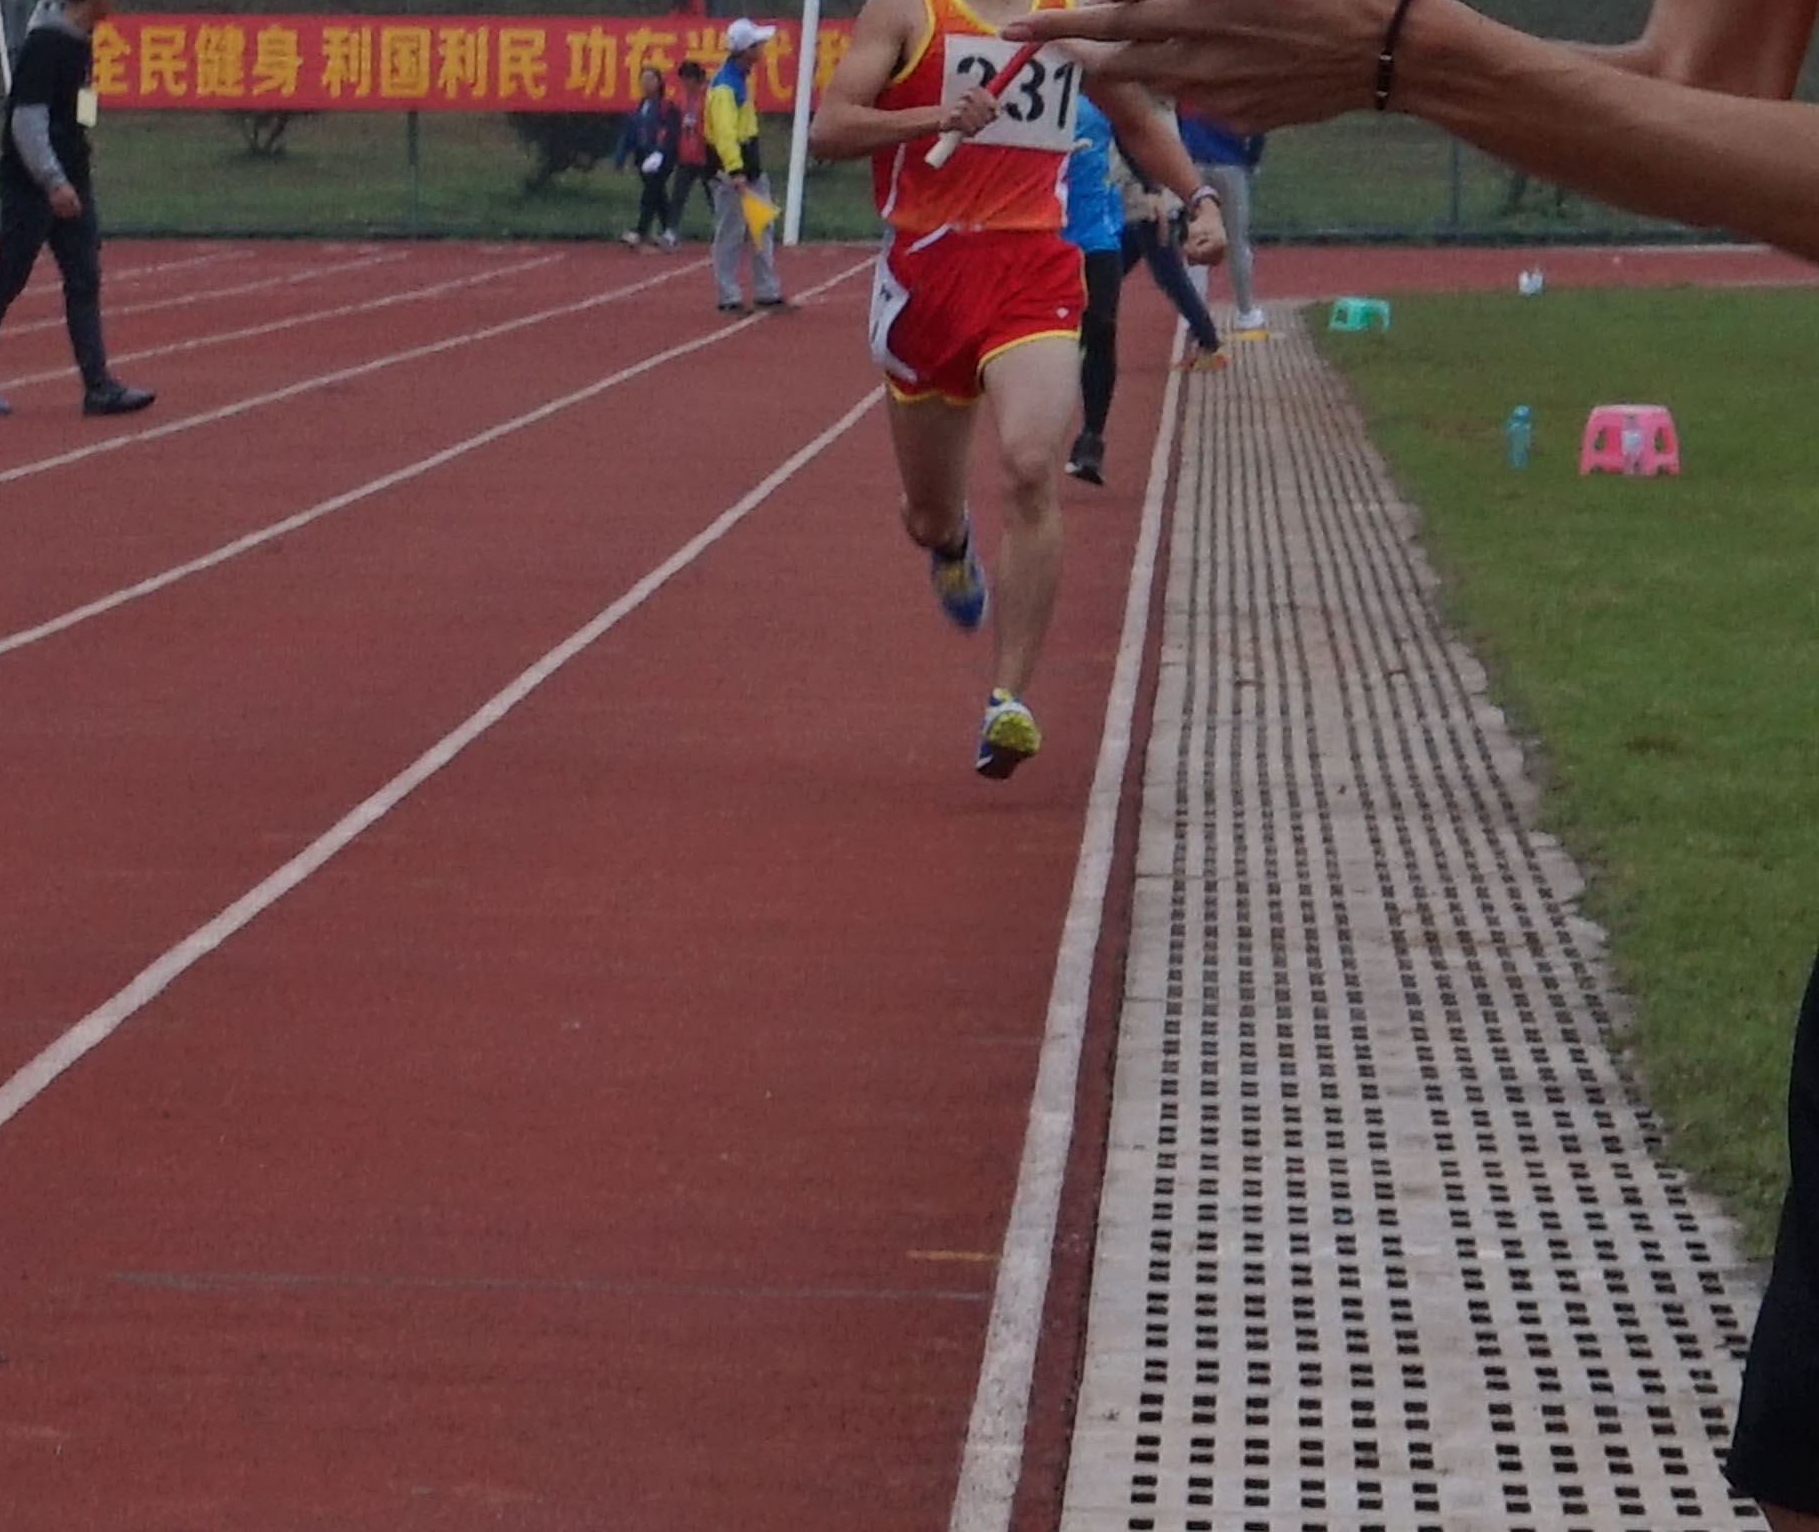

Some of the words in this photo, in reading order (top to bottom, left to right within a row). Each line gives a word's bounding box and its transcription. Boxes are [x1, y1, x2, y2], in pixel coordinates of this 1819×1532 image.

[92, 22, 302, 97] 全民健身
[322, 24, 547, 99] 利国利民
